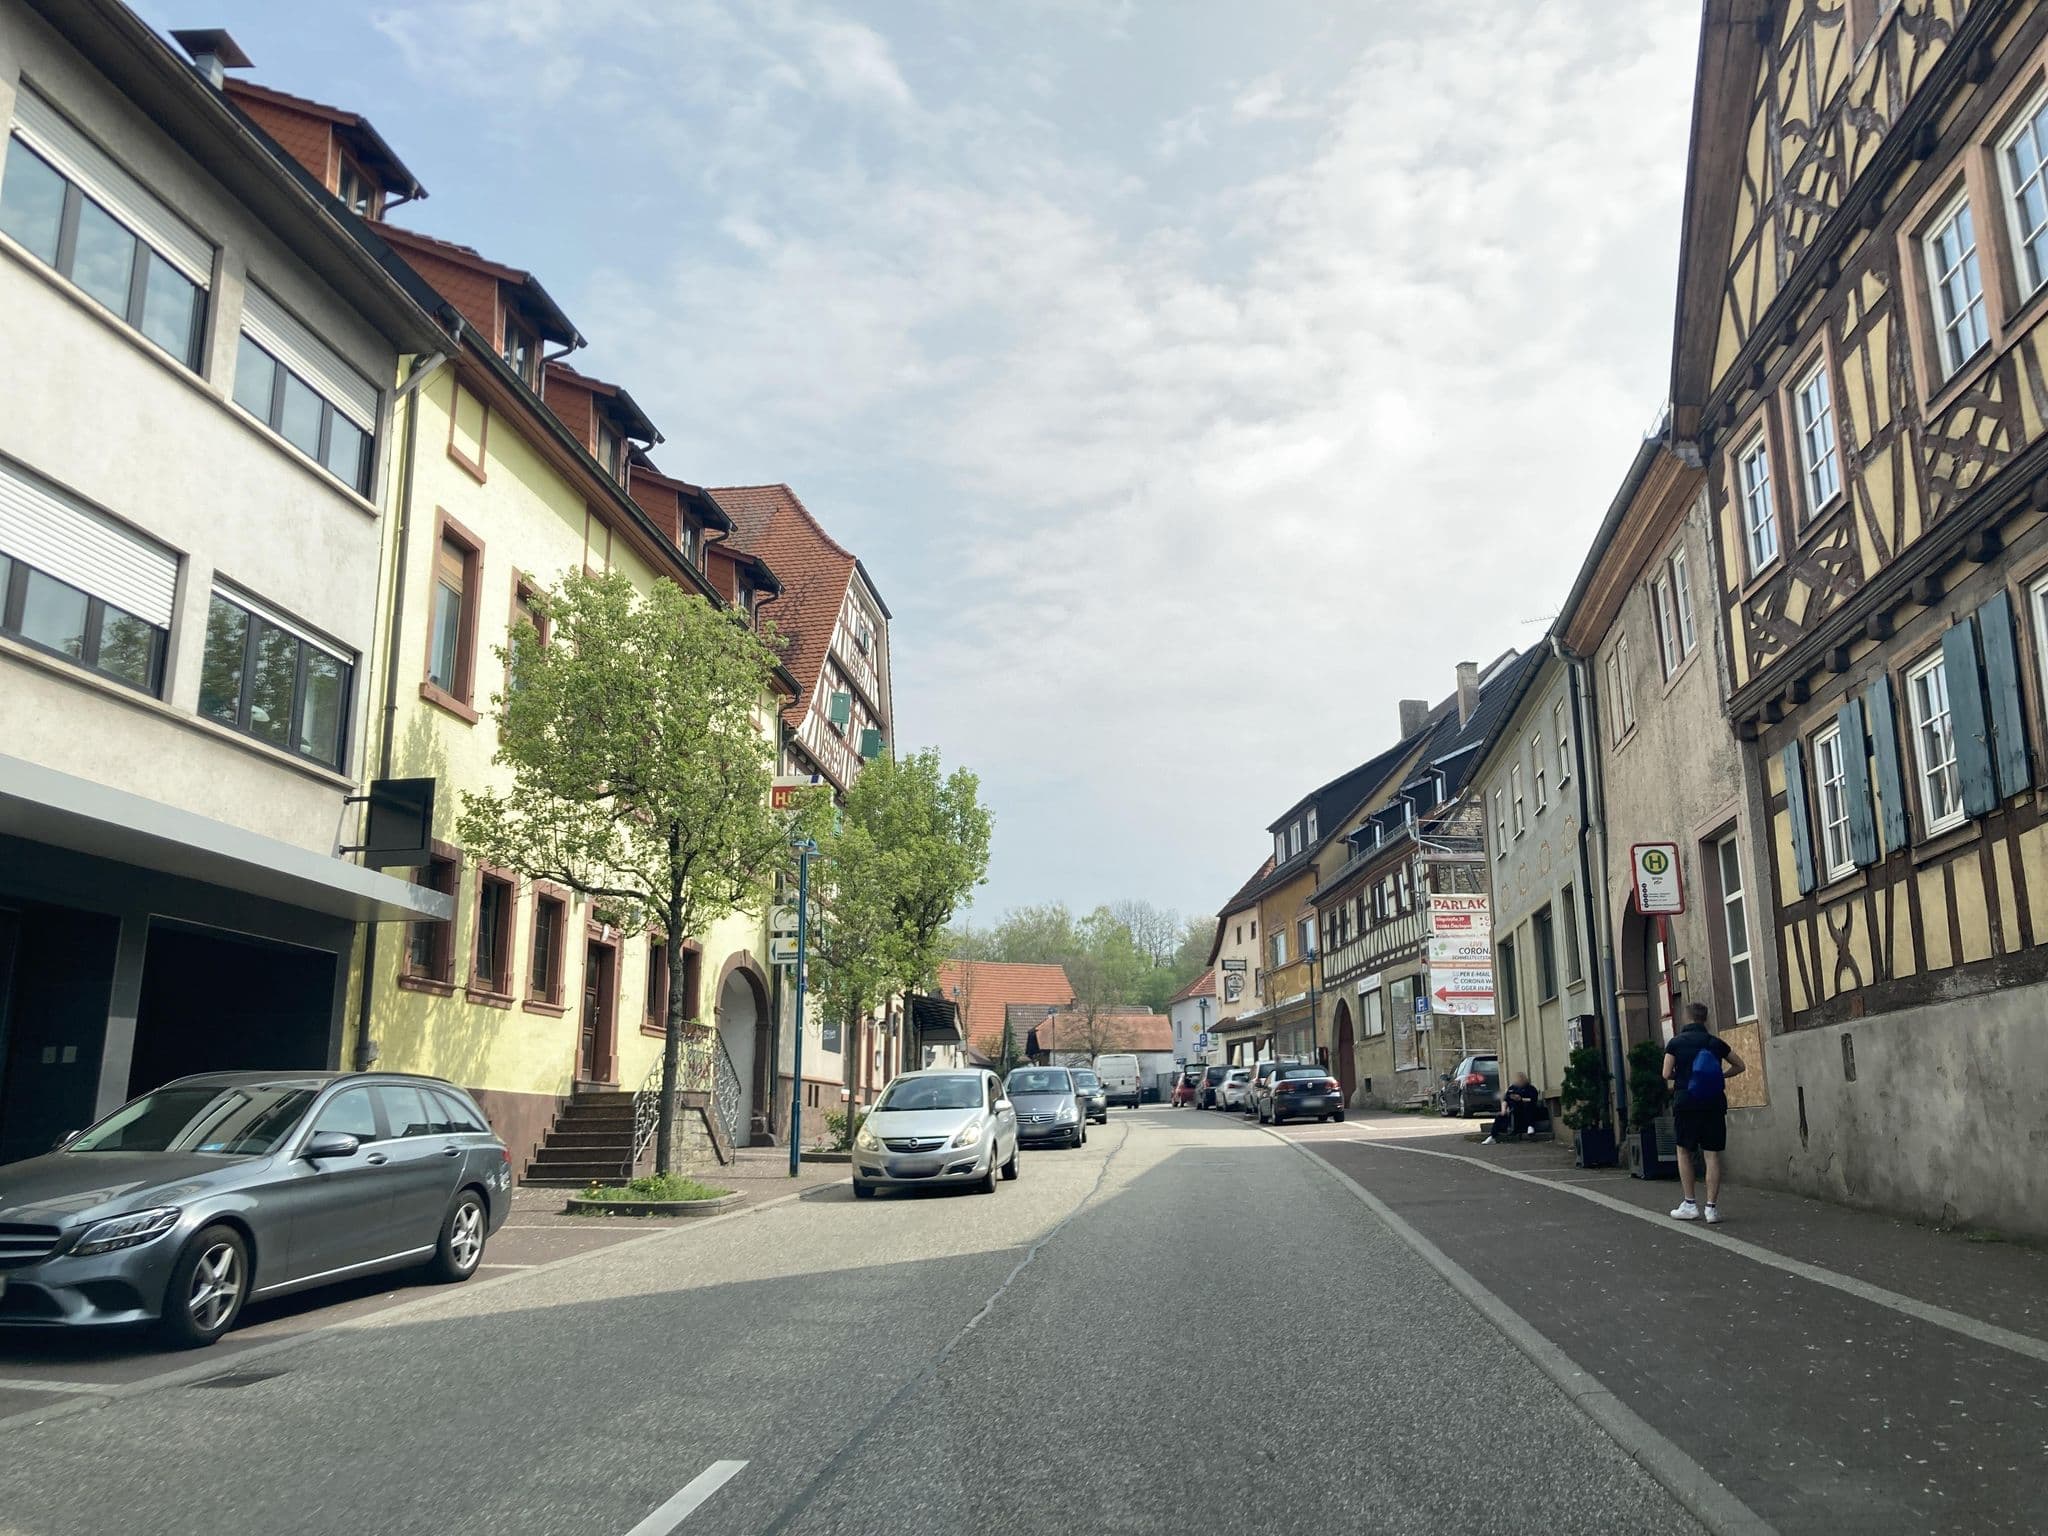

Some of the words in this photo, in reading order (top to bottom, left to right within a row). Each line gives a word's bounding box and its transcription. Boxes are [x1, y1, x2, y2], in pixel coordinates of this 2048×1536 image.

[1649, 856, 1662, 870] H
[1434, 898, 1487, 910] PARLAK
[1458, 947, 1491, 955] CORON
